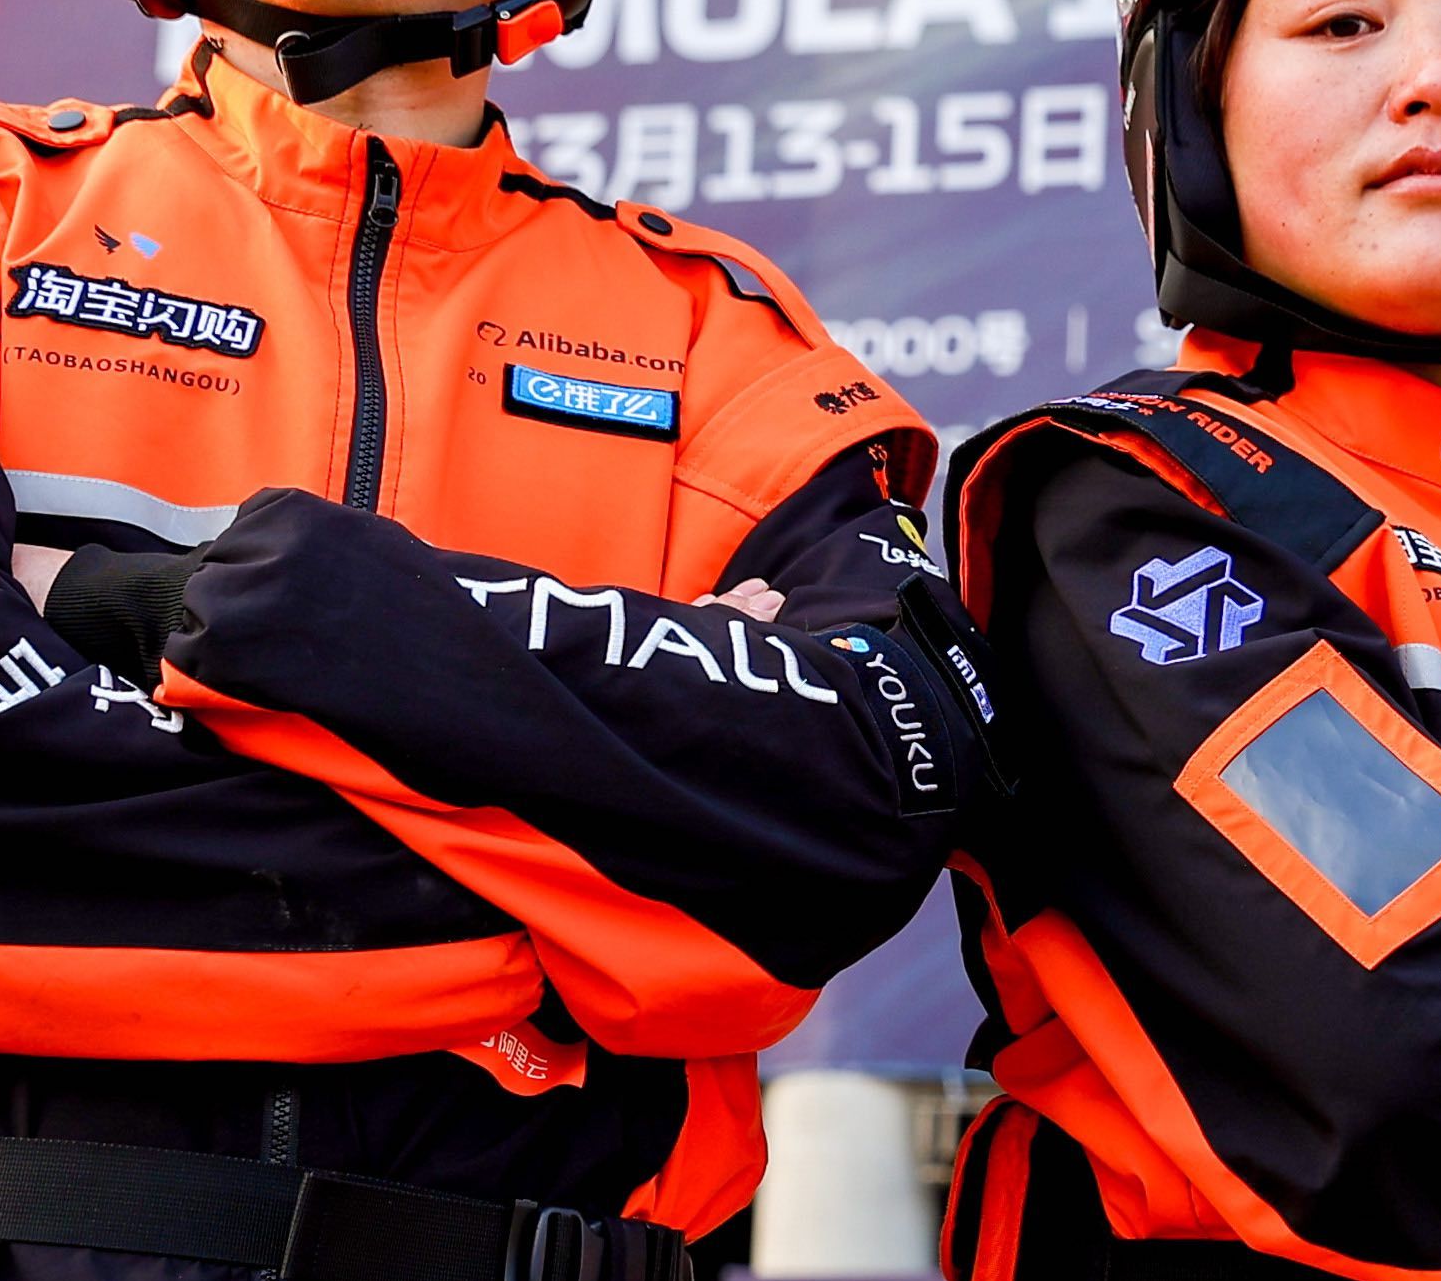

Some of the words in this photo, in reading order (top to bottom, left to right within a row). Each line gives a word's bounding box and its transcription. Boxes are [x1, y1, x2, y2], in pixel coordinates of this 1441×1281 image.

[16, 266, 259, 353] 淘宝闪购
[2, 345, 242, 397] (TAOBAOSHANGOU)
[514, 327, 687, 376] Alibaba.com
[1186, 410, 1275, 475] RIDER
[455, 575, 838, 705] TMALL
[865, 653, 939, 792] YOUKU
[498, 1030, 548, 1081] 阿里云
